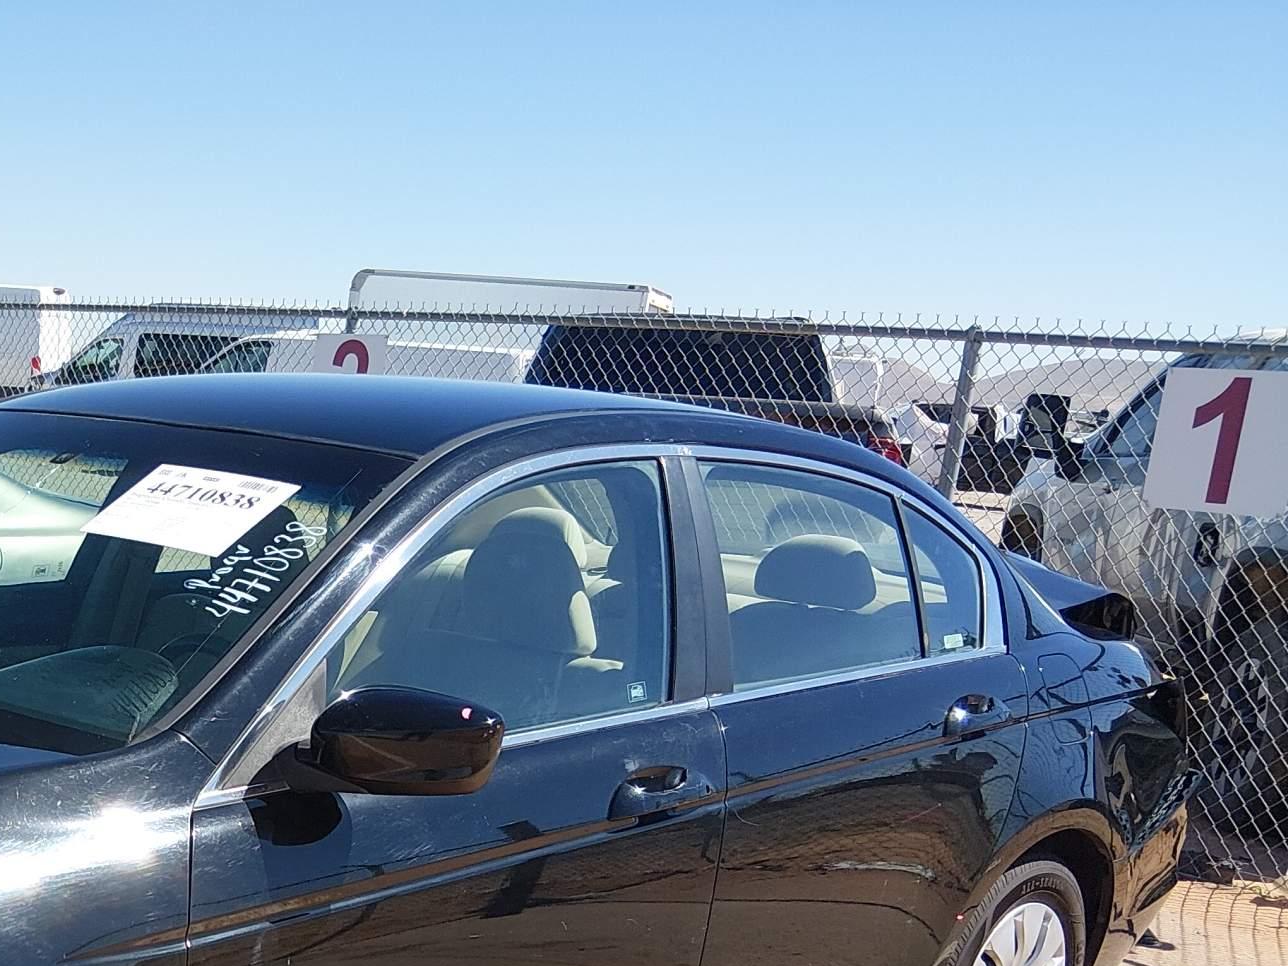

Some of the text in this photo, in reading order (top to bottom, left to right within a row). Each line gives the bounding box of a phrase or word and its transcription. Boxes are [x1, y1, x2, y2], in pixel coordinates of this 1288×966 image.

[1192, 377, 1253, 504] 1
[146, 481, 261, 510] 44710838
[205, 521, 328, 618] 44710838
